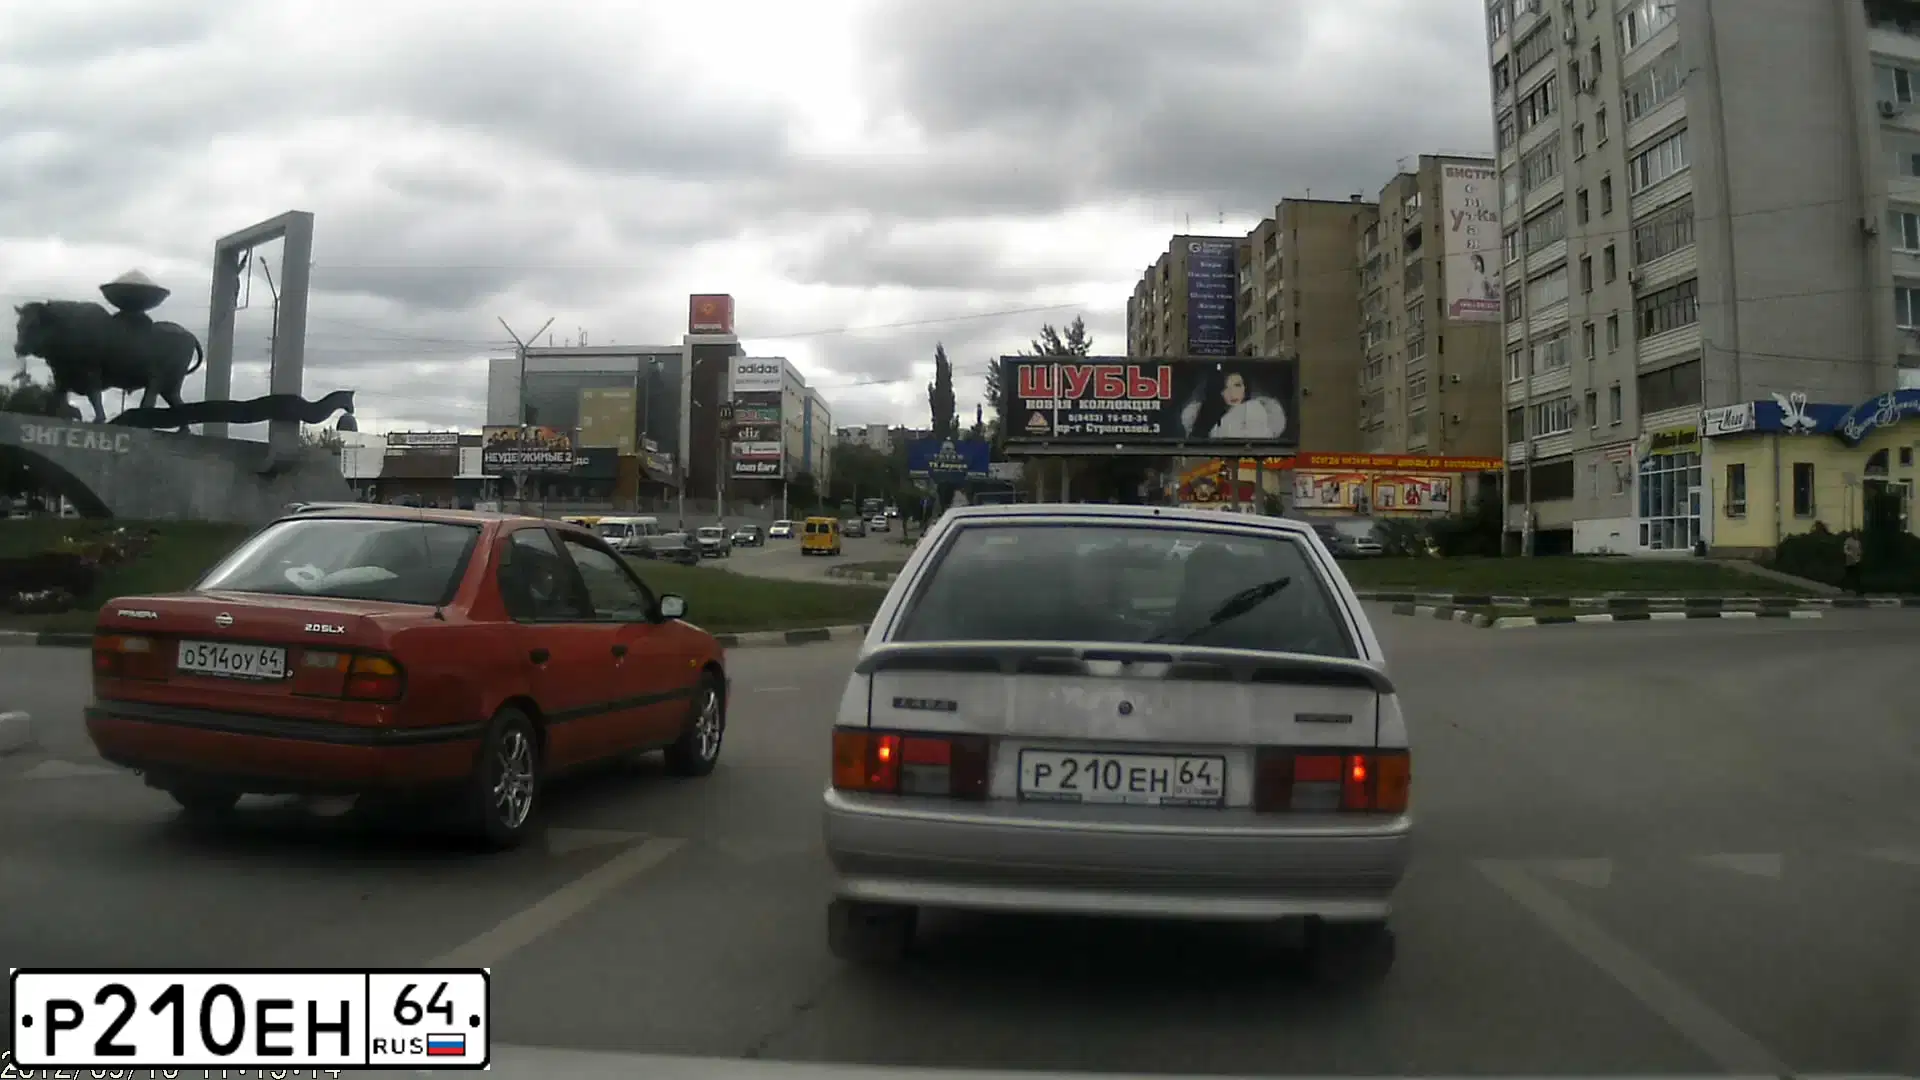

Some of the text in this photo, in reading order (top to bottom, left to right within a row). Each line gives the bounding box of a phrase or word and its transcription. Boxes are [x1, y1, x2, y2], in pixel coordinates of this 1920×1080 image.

[738, 364, 779, 374] adidas
[1018, 365, 1172, 399] ШУБЫ
[20, 424, 130, 453] ЭНГЕЛЬС
[485, 451, 564, 463] НЕУДЕЖИМЫЕ
[1179, 760, 1211, 787] 64
